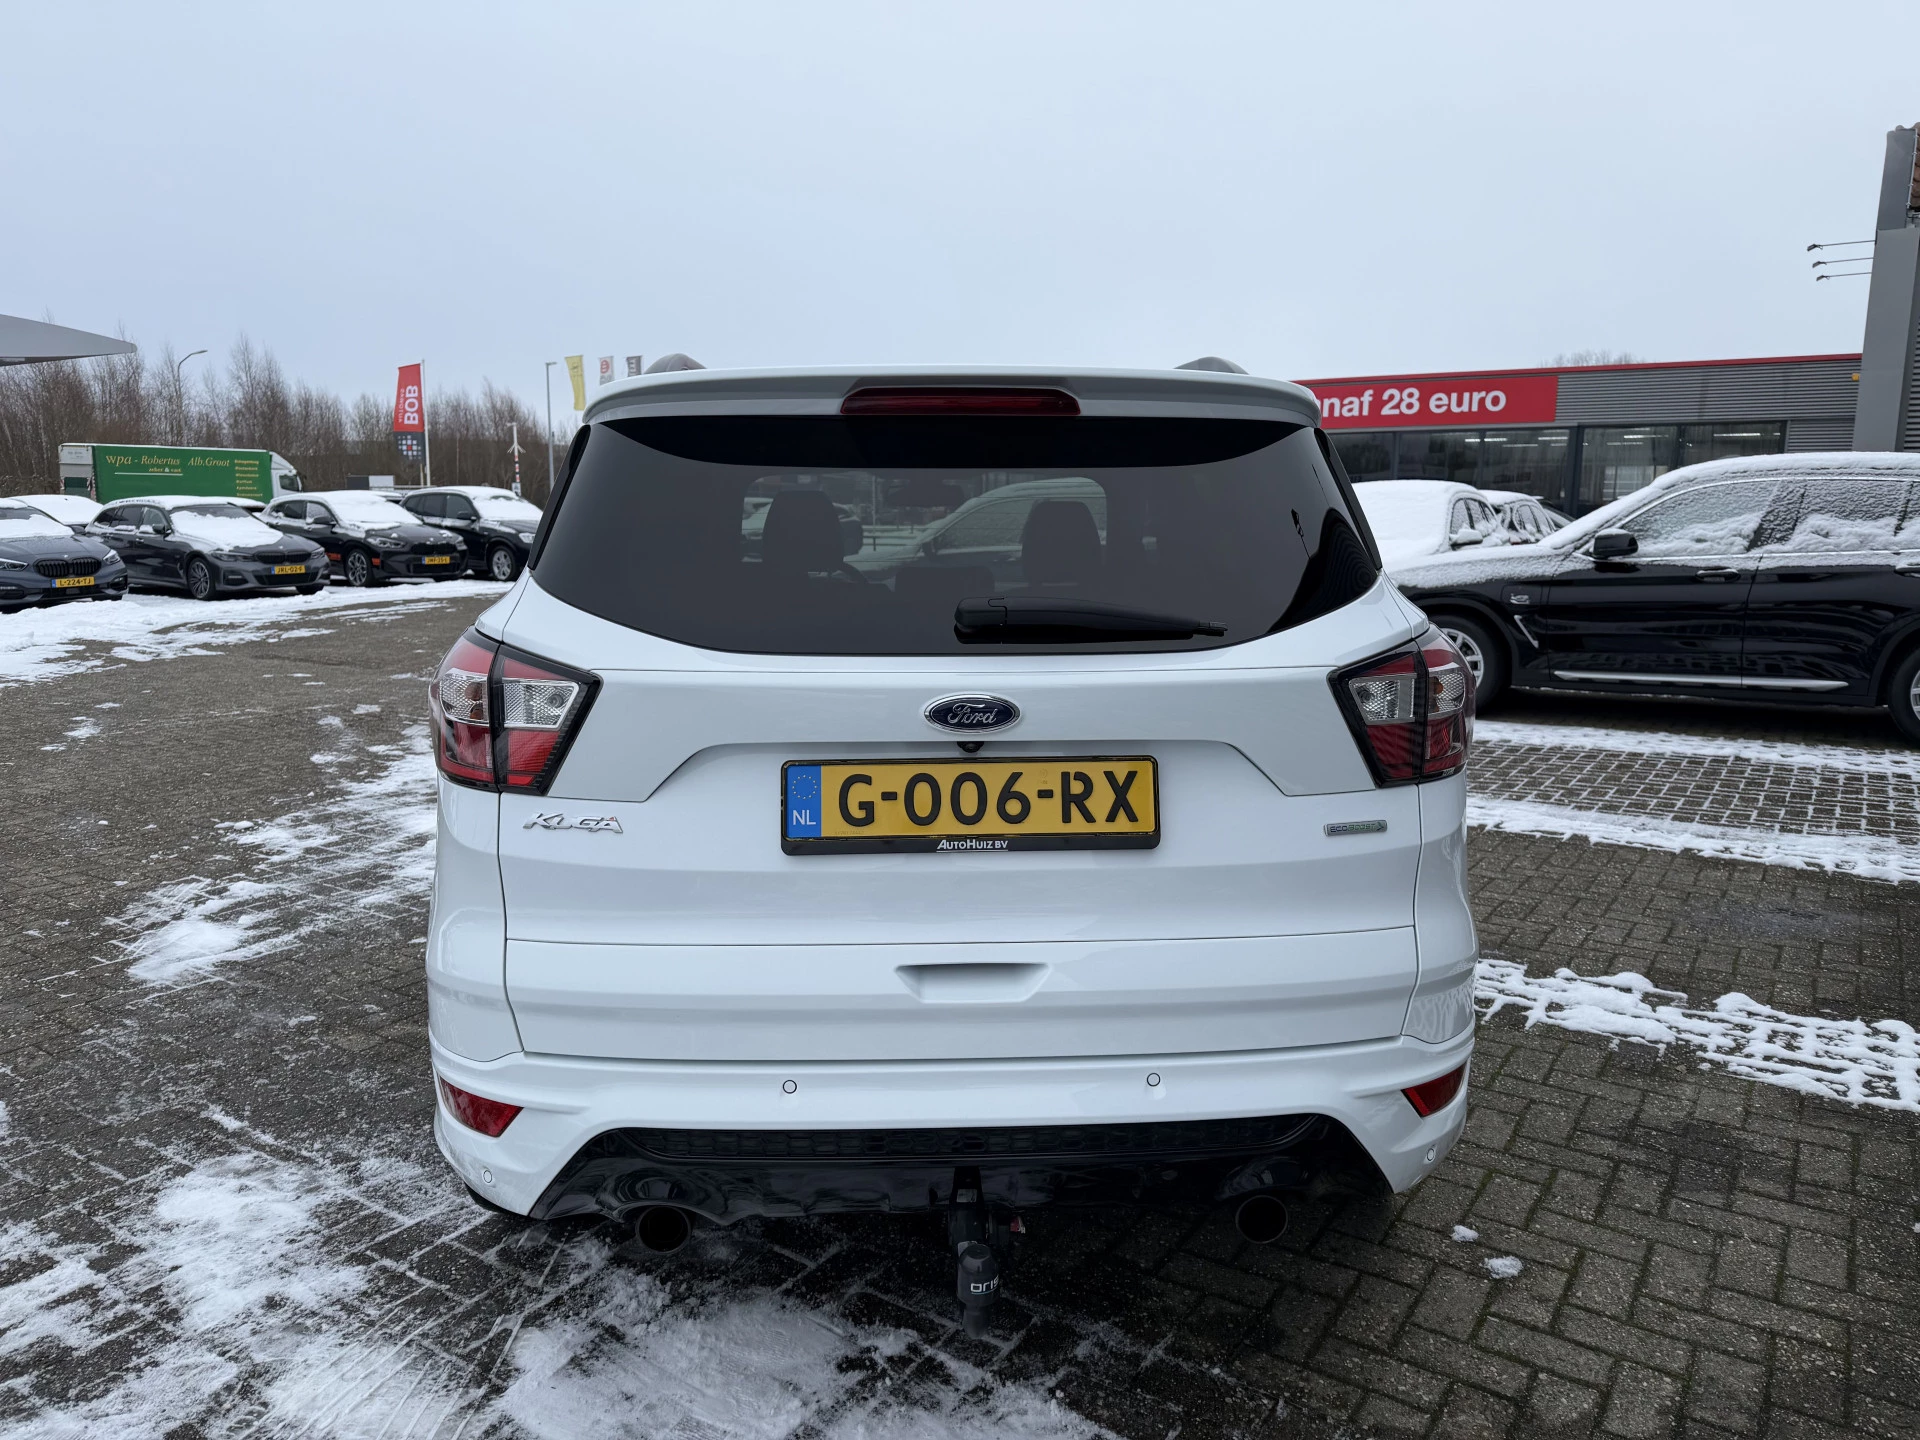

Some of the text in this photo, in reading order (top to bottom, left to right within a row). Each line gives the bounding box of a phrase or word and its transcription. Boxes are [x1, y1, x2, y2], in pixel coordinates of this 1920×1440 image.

[1380, 387, 1420, 416] 28
[1429, 390, 1507, 413] euro
[105, 455, 132, 467] wpa
[141, 455, 180, 465] Robertus
[947, 702, 998, 724] Ford
[838, 770, 1139, 827] G-006-RX
[522, 812, 624, 834] KUGA
[792, 810, 816, 825] NL
[995, 840, 1009, 849] BV
